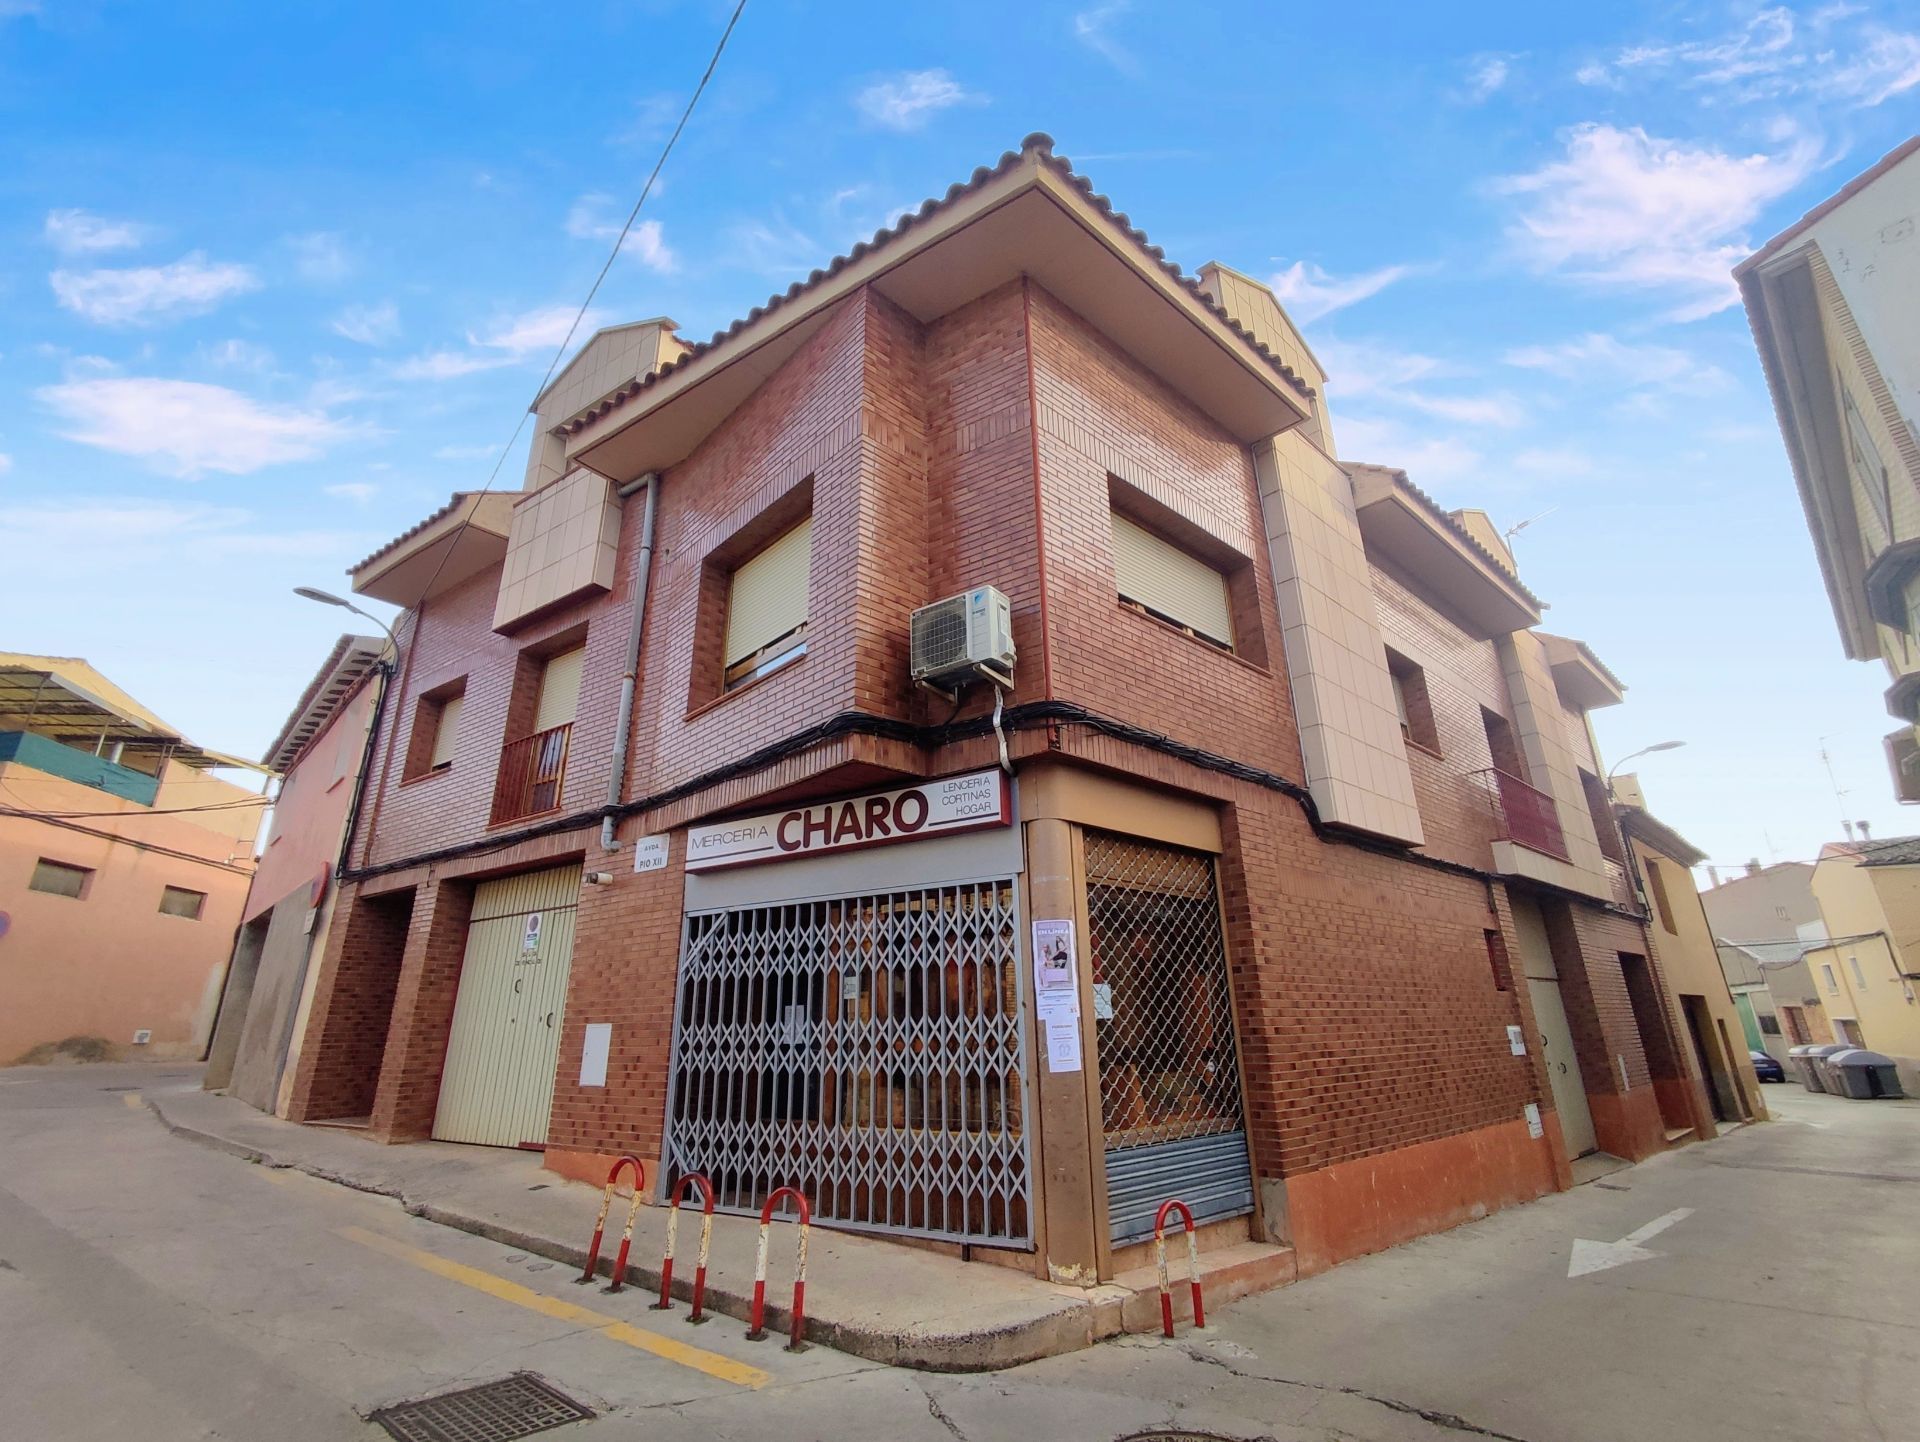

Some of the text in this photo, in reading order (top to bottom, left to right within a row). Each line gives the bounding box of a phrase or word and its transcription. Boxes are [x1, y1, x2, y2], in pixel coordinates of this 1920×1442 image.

[943, 777, 990, 793] LENCERIA
[942, 789, 991, 805] CORTINAS
[955, 801, 992, 817] HOGAR
[776, 789, 929, 851] CHARO
[691, 825, 769, 850] MERCERIA
[640, 857, 662, 868] PIO XII
